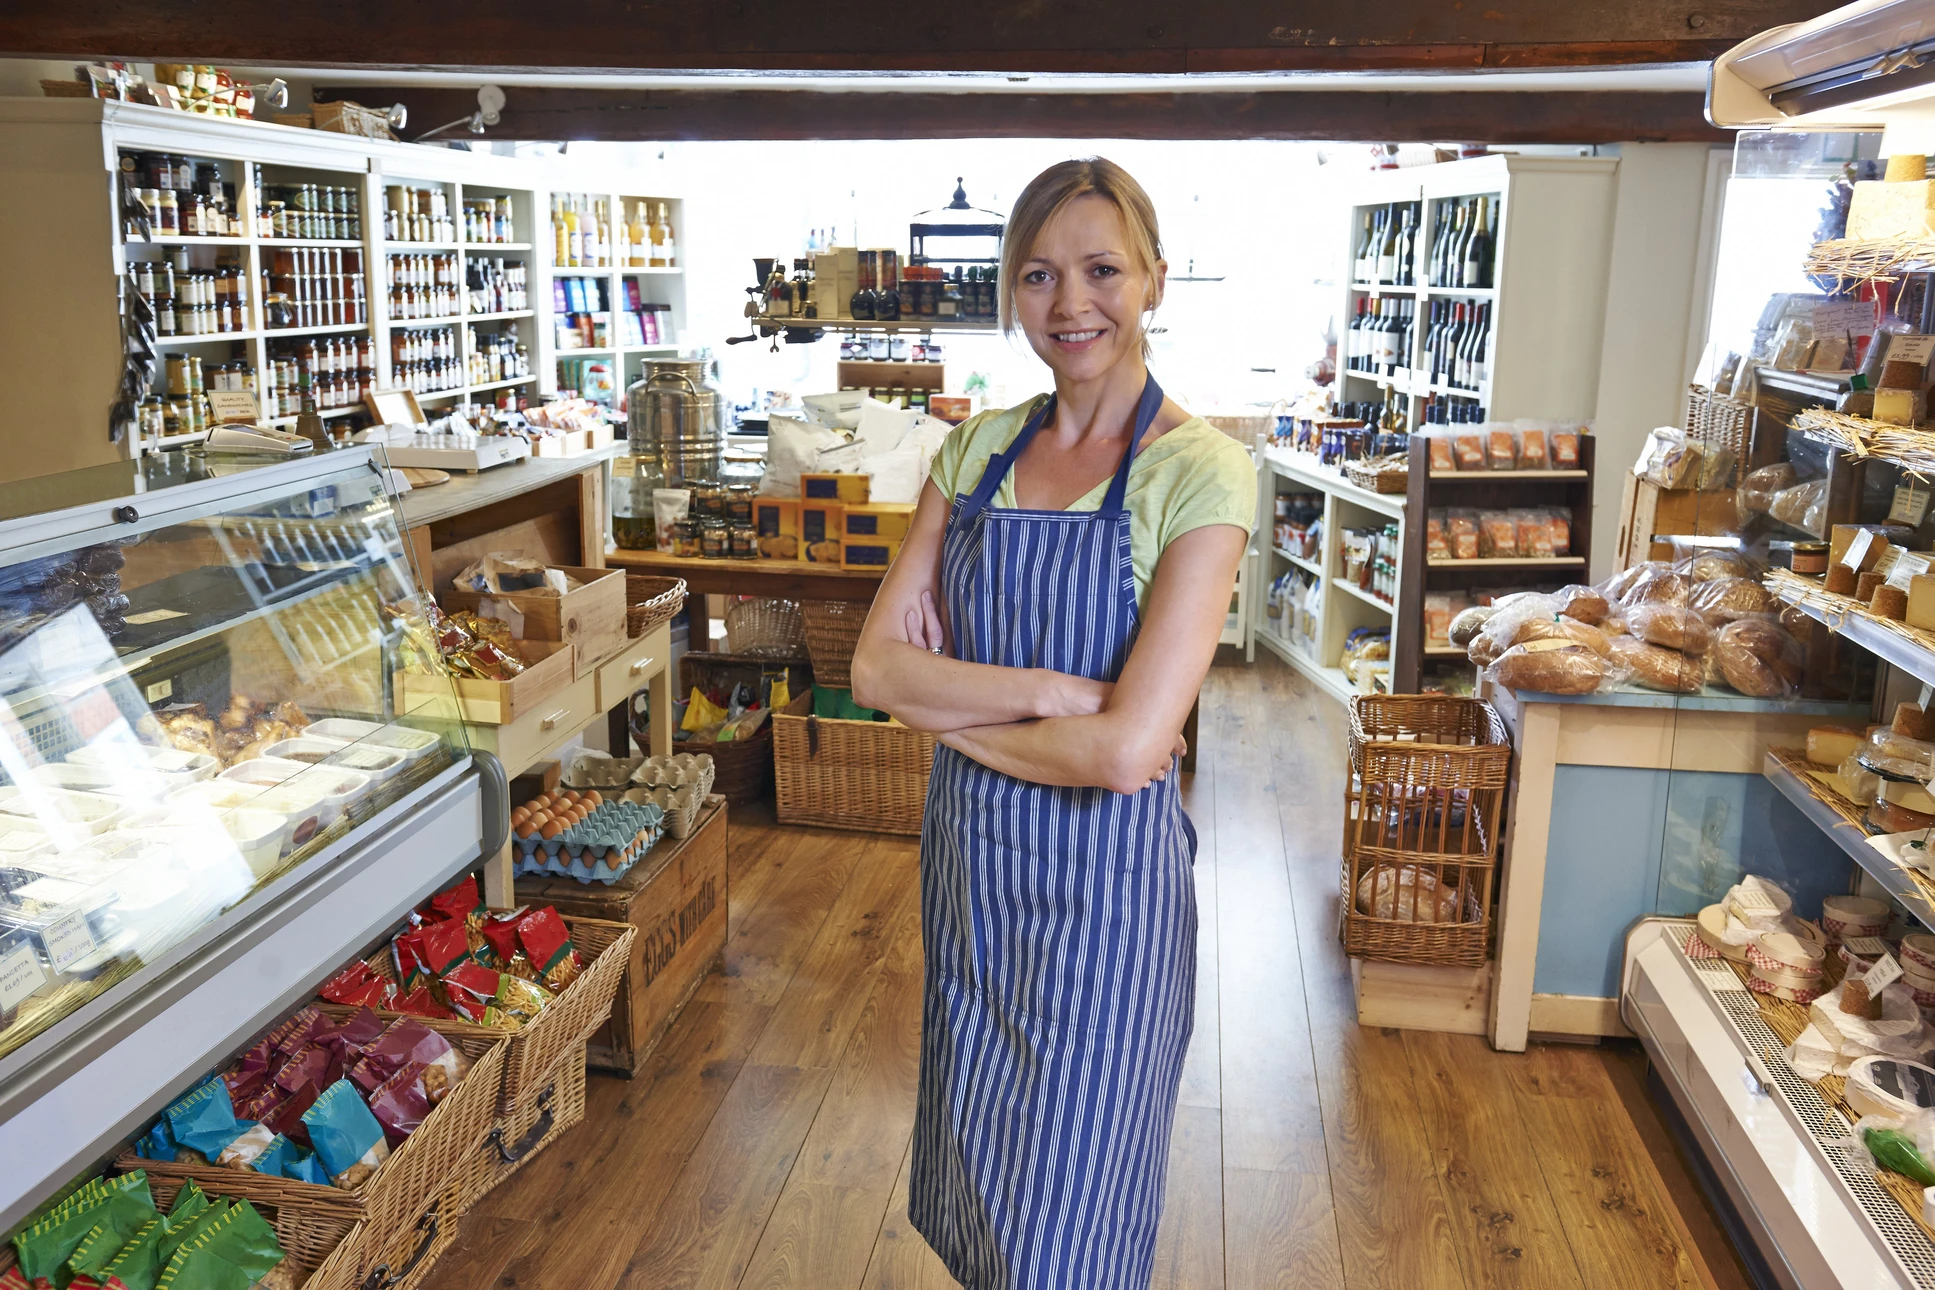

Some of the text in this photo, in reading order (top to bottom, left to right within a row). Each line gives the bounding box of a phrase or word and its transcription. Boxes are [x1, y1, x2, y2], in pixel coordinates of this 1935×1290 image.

[50, 916, 76, 935] COUNTRY
[48, 930, 72, 948] SMOKED
[644, 908, 677, 988] EGGS
